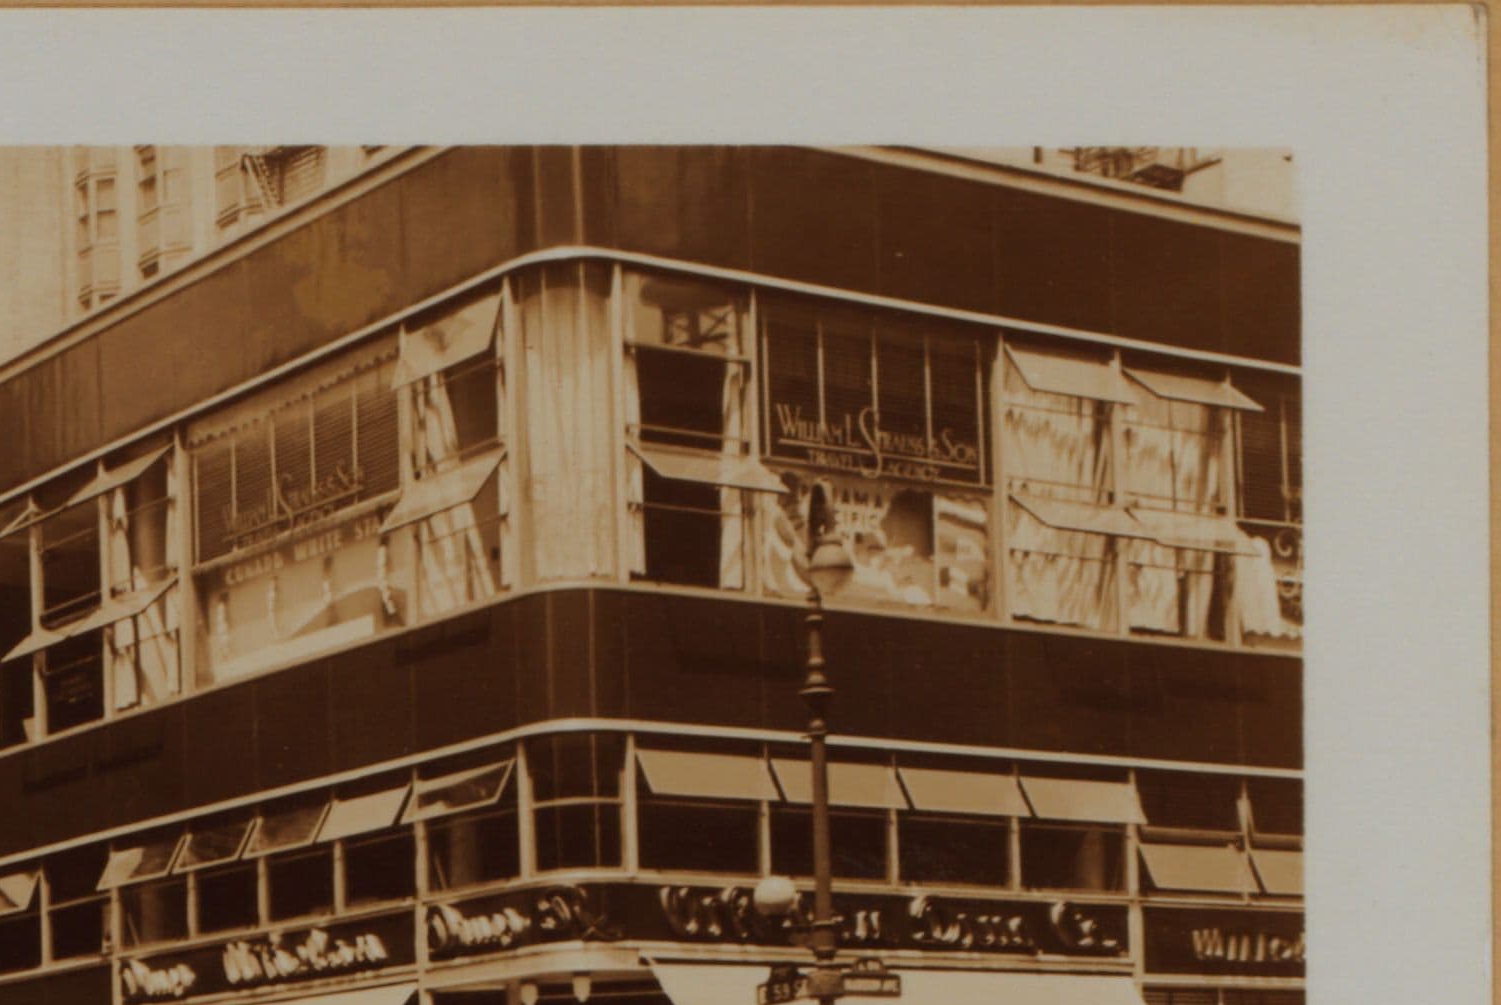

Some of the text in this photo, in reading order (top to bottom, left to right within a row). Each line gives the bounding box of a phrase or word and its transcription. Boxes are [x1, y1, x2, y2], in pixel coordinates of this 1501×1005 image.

[225, 551, 285, 586] CUNARD
[295, 528, 342, 562] WHITE
[355, 512, 383, 541] STA
